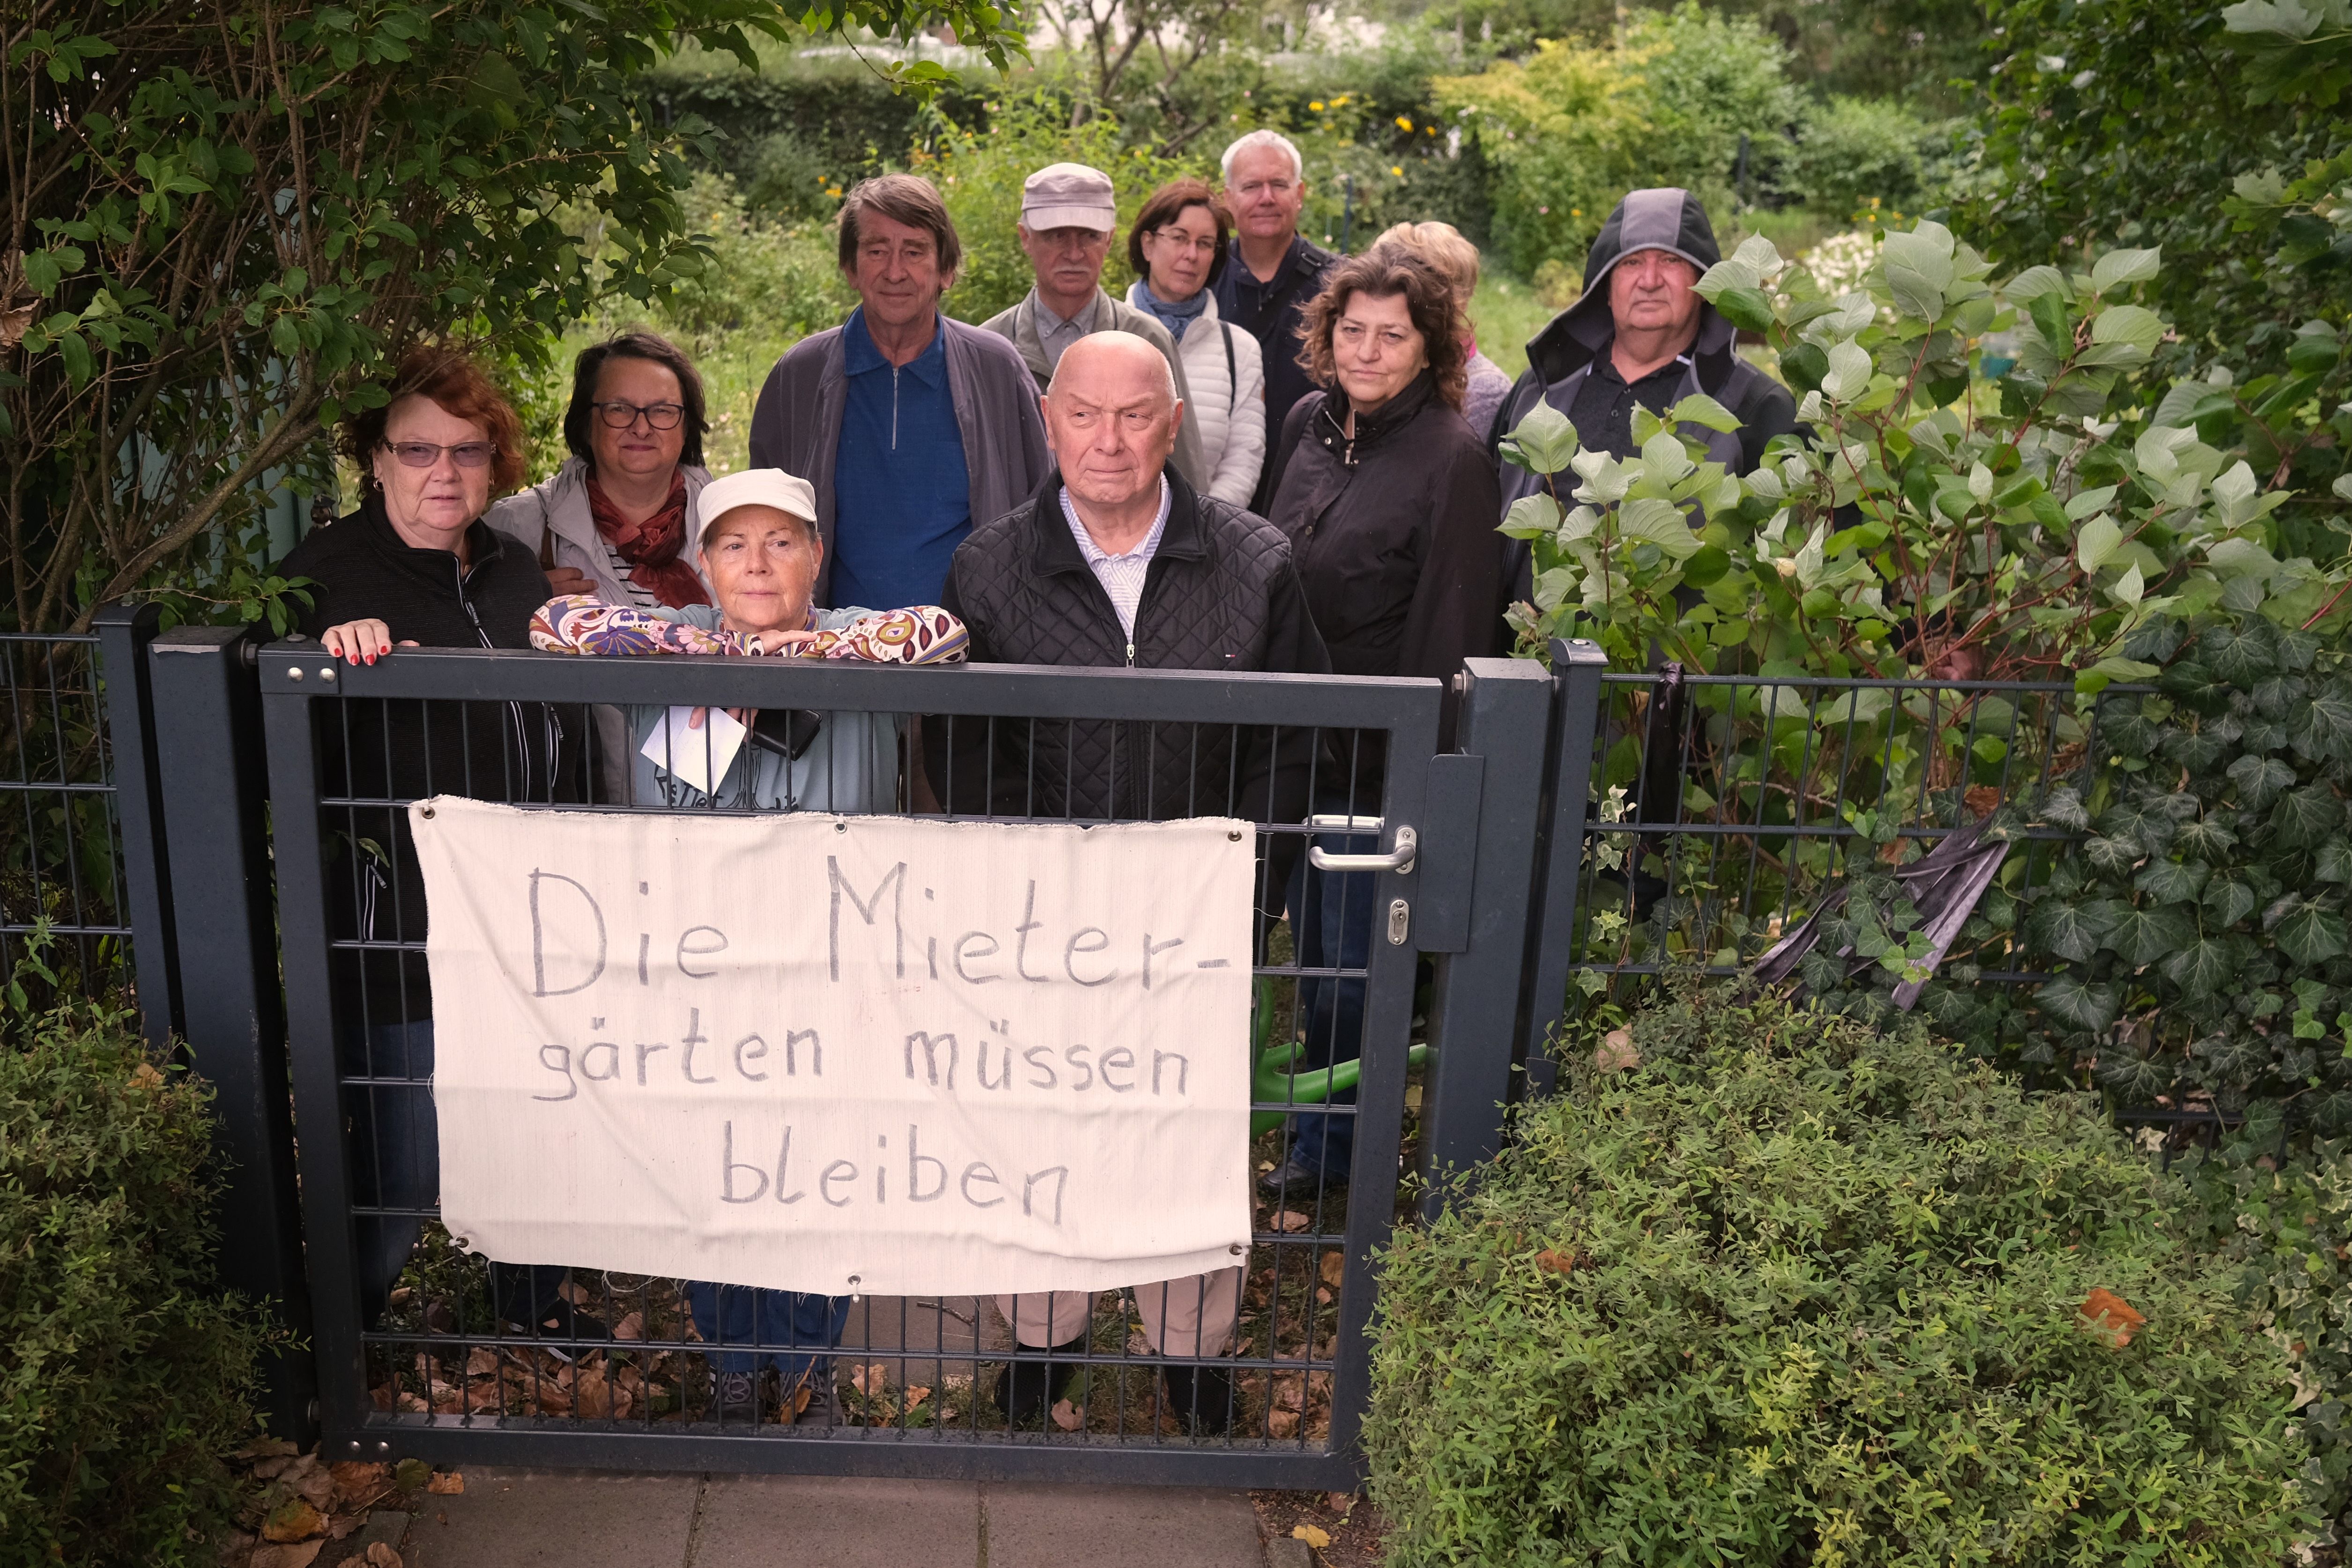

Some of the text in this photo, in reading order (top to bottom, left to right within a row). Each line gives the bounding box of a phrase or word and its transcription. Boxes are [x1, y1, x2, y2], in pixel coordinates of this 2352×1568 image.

[527, 855, 1231, 998] Die Mieter-
[531, 1007, 1188, 1102] gärten müssen
[720, 1120, 1069, 1226] bleiben
